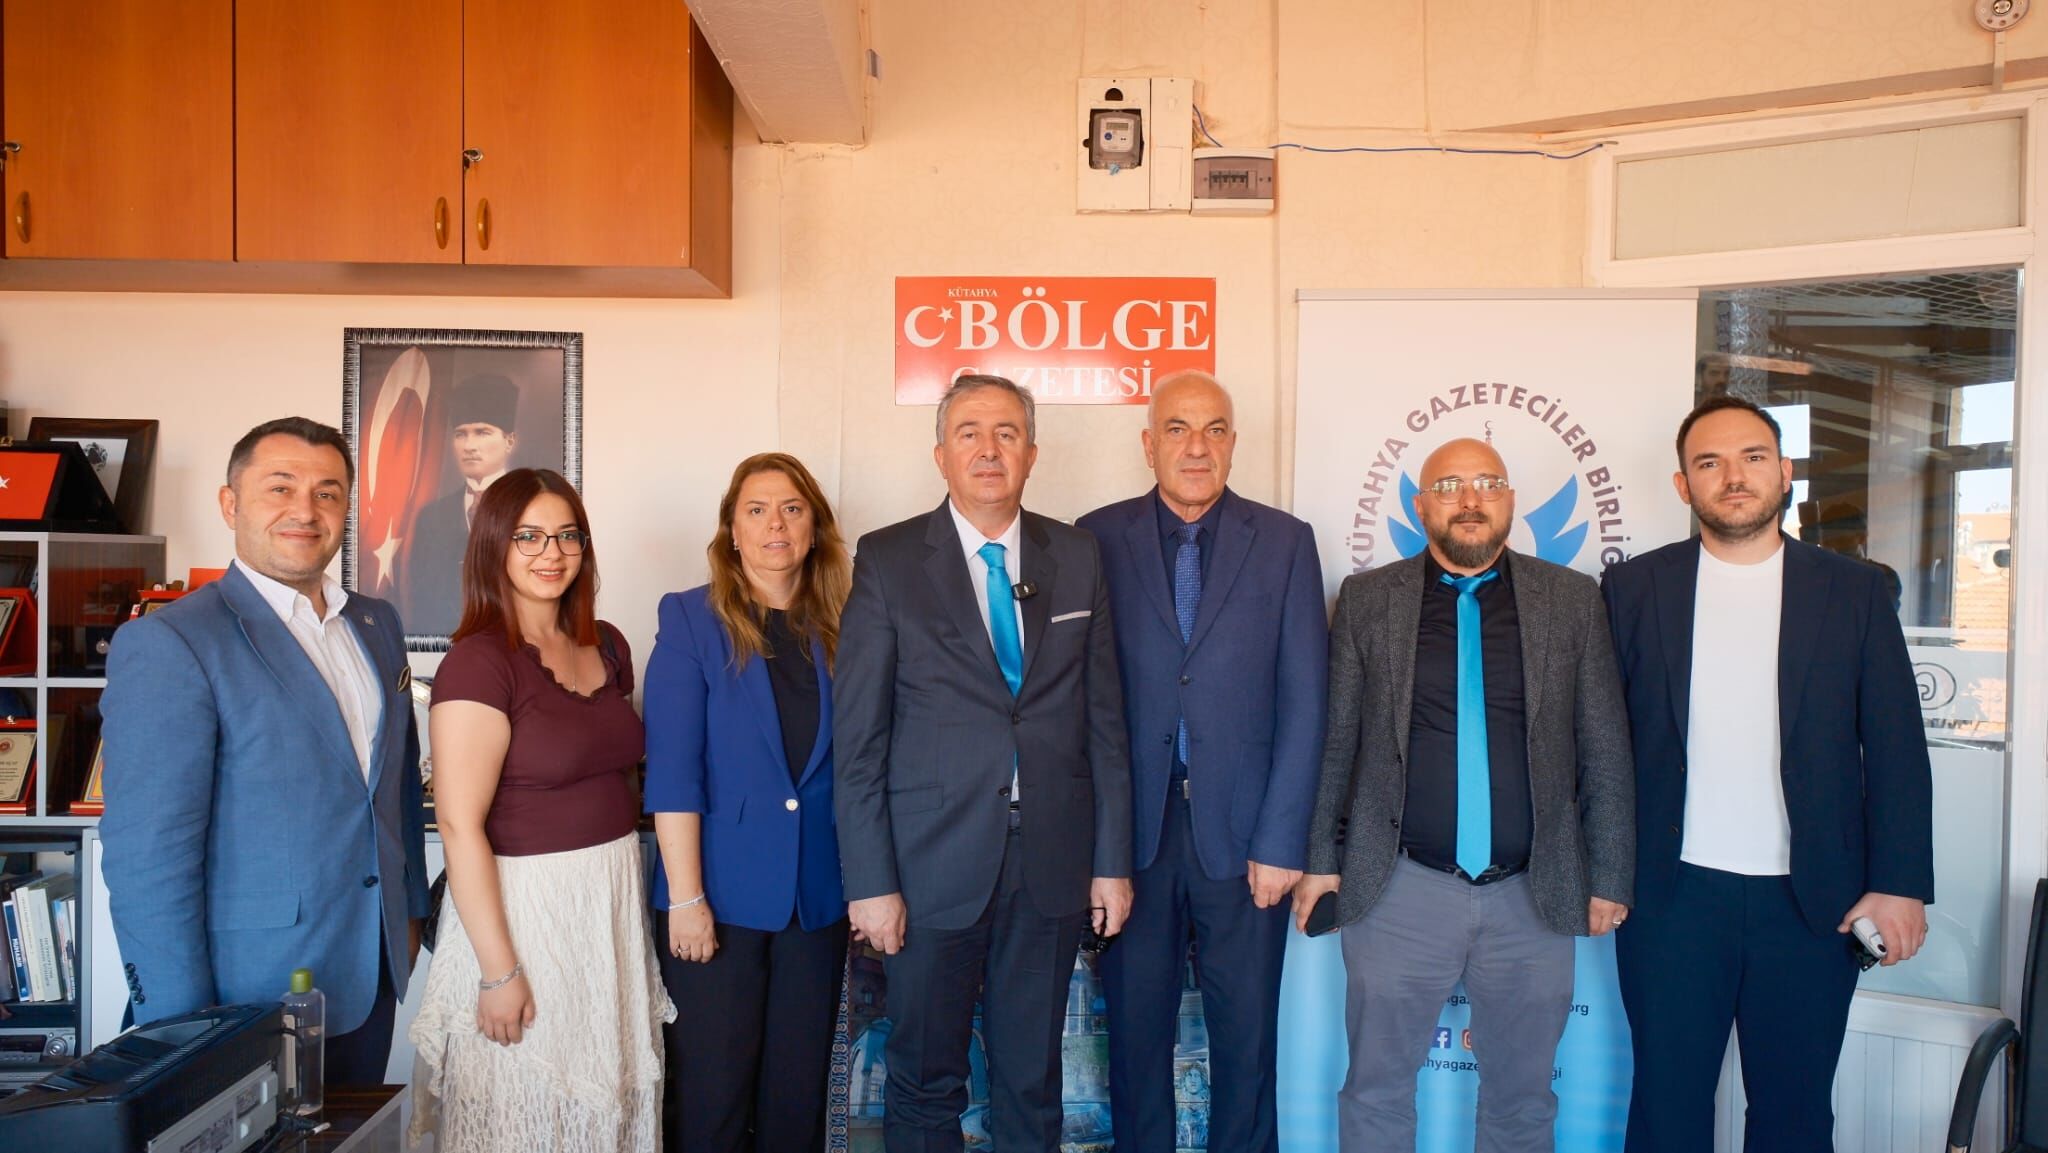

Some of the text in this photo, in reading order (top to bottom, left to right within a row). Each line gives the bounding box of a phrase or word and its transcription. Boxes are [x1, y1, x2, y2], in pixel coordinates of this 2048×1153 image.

[948, 286, 998, 298] KÜTAHYA
[953, 286, 1210, 351] BÖLGE
[1345, 382, 1632, 578] KÜTAHYA GAZETECİLER BİRLİĞ
